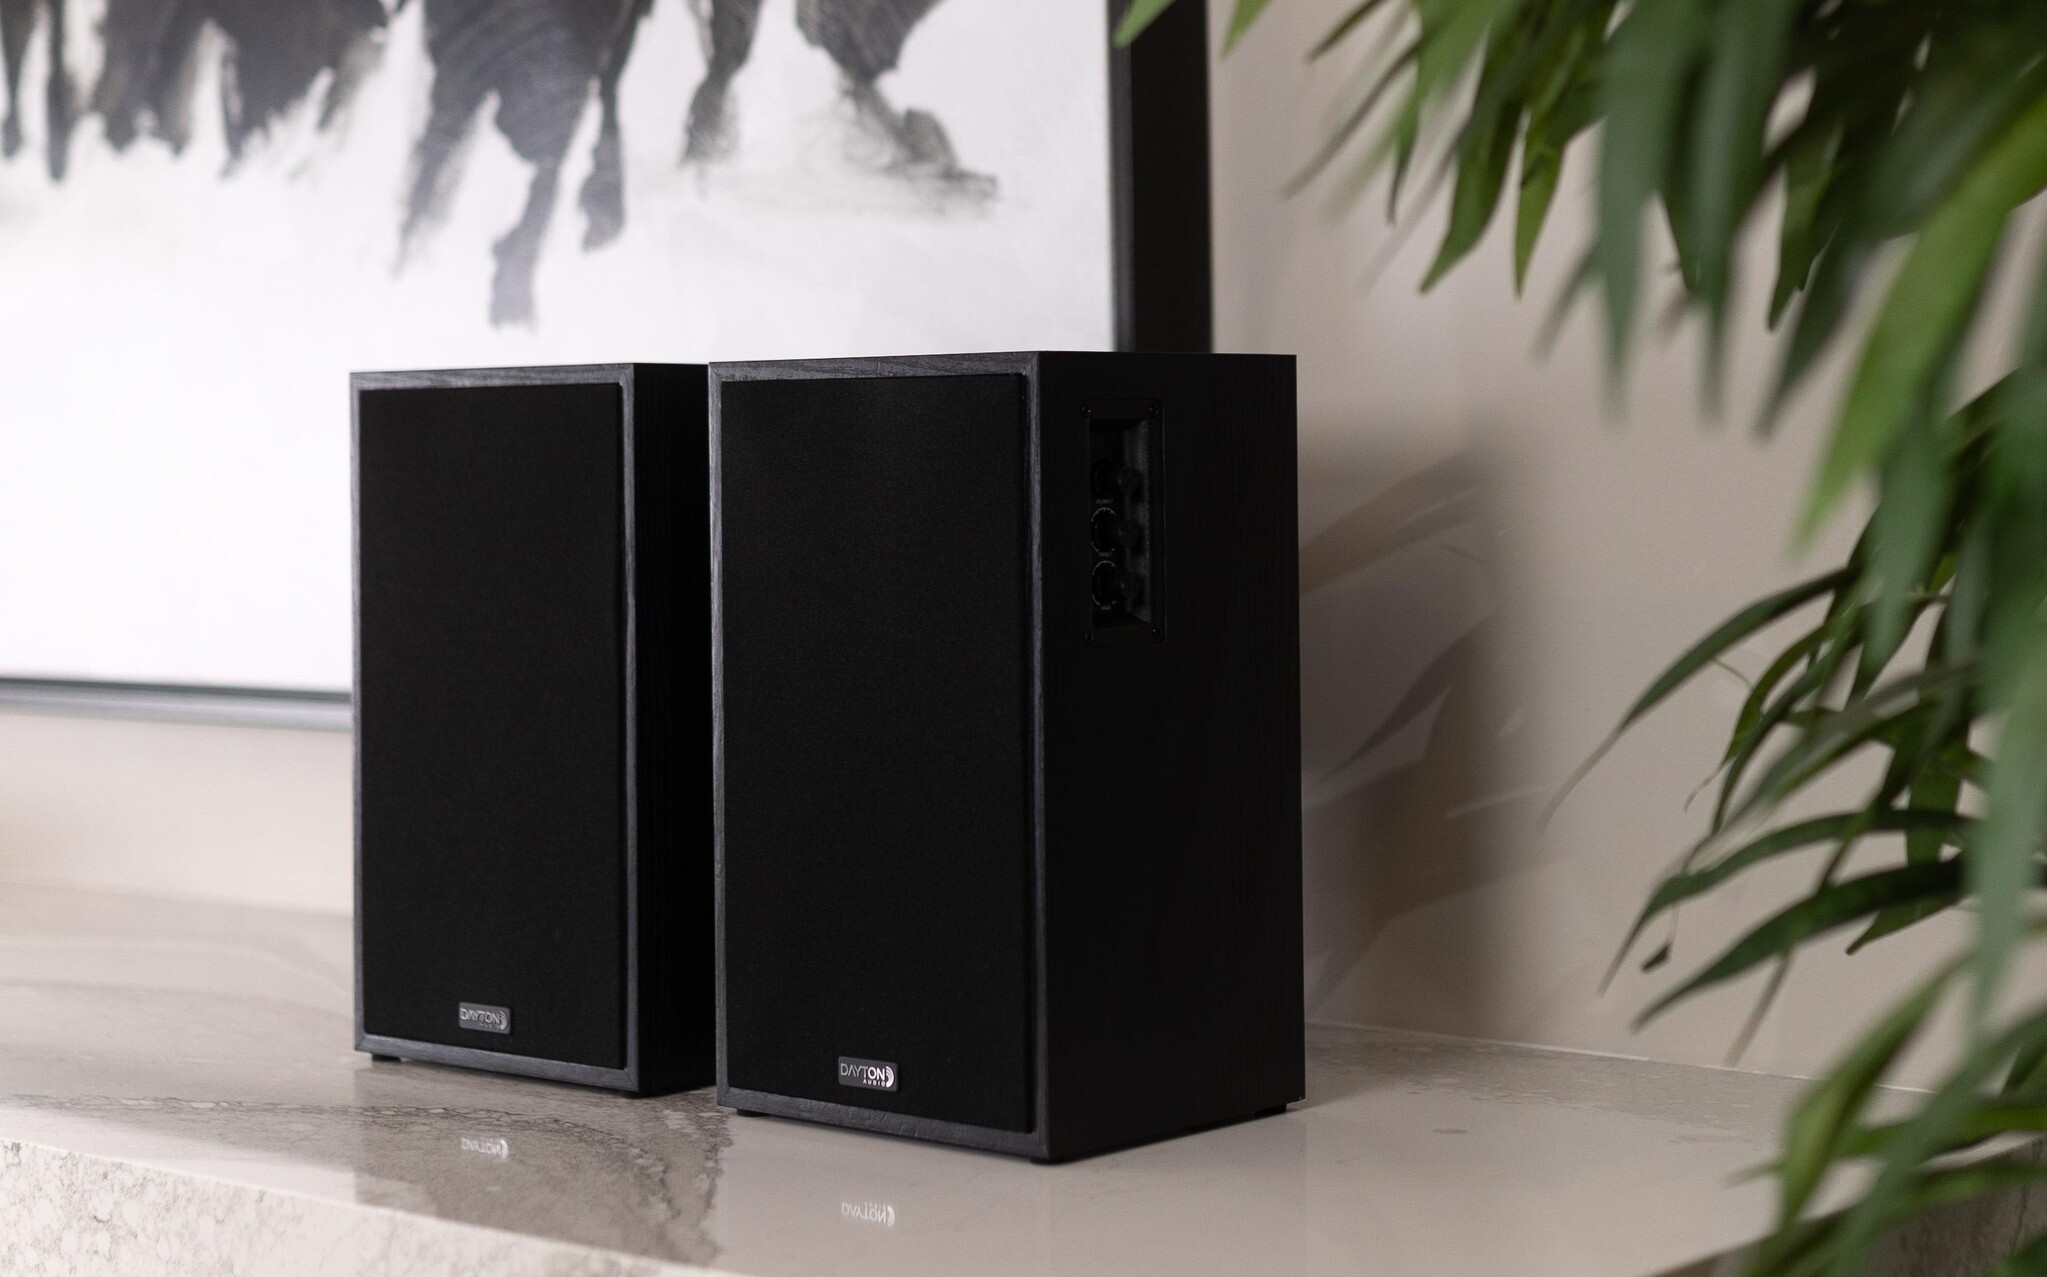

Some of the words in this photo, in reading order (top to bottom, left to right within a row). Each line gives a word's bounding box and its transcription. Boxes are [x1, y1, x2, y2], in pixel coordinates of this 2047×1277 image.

[460, 1007, 500, 1023] DAYTON
[841, 1064, 885, 1081] DAYTON
[863, 1079, 886, 1088] AUDIO
